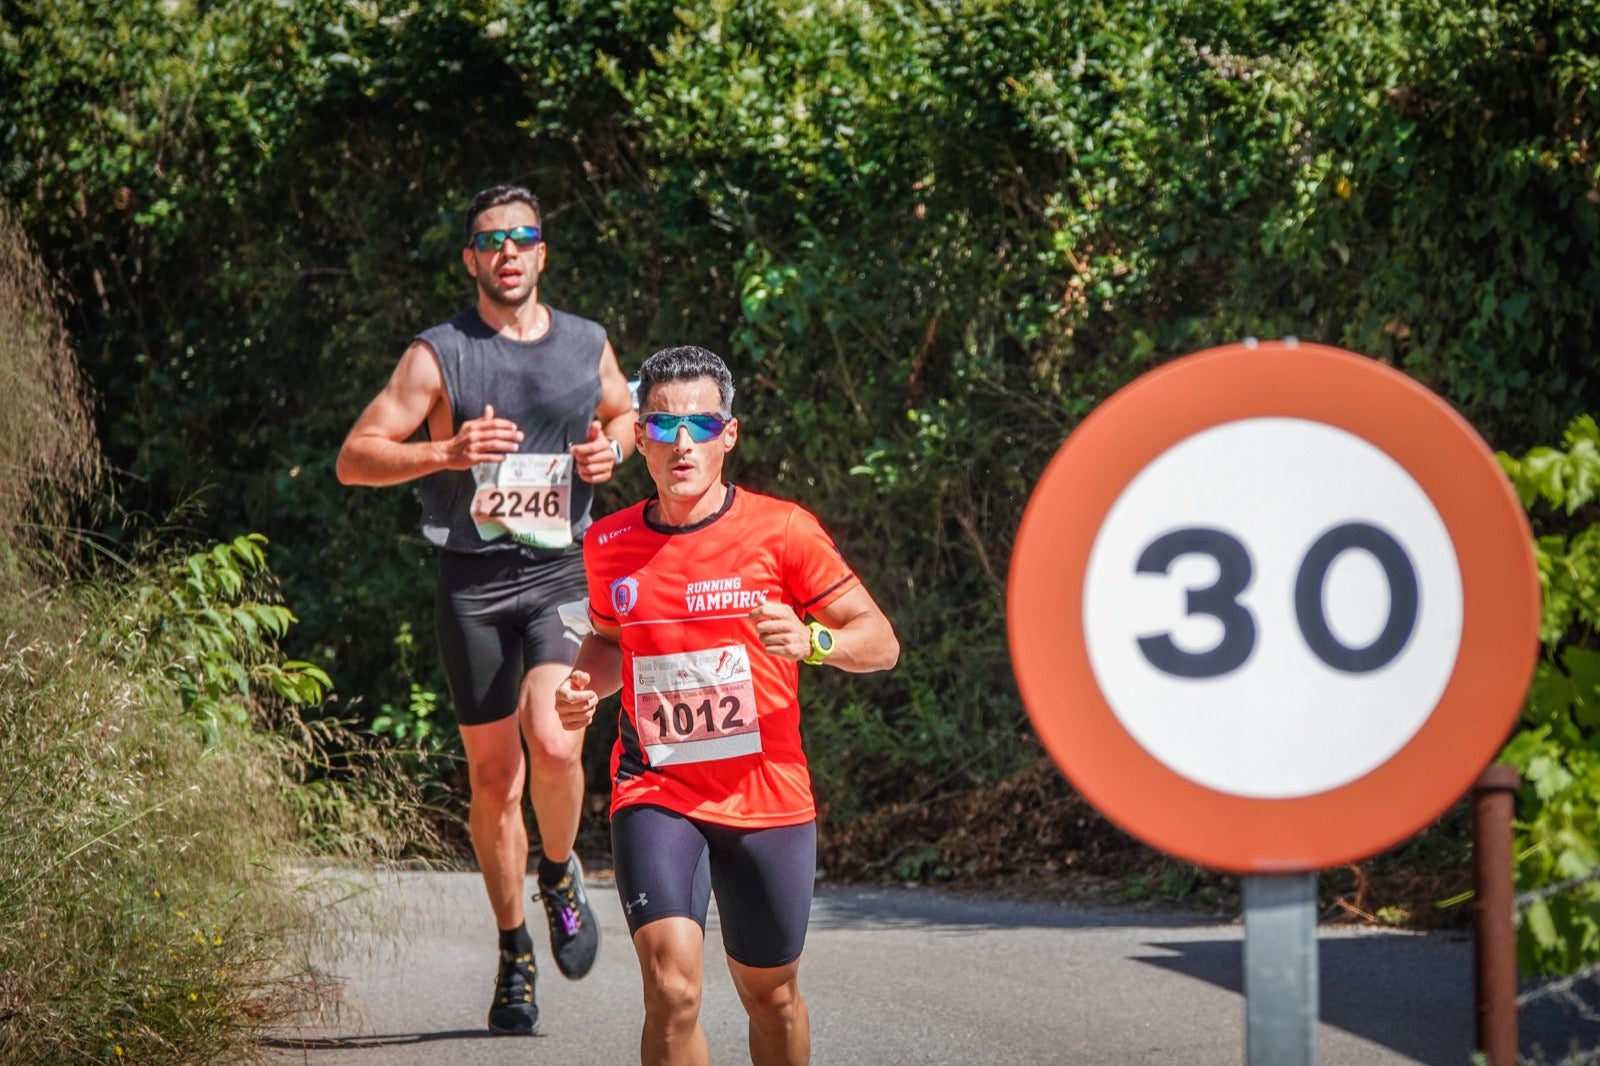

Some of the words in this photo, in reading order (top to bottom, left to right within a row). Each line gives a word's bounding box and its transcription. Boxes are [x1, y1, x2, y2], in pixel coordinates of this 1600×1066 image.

[488, 491, 560, 518] 2246
[686, 577, 741, 595] RUNNING
[1135, 521, 1420, 680] 30
[652, 695, 744, 737] 1012
